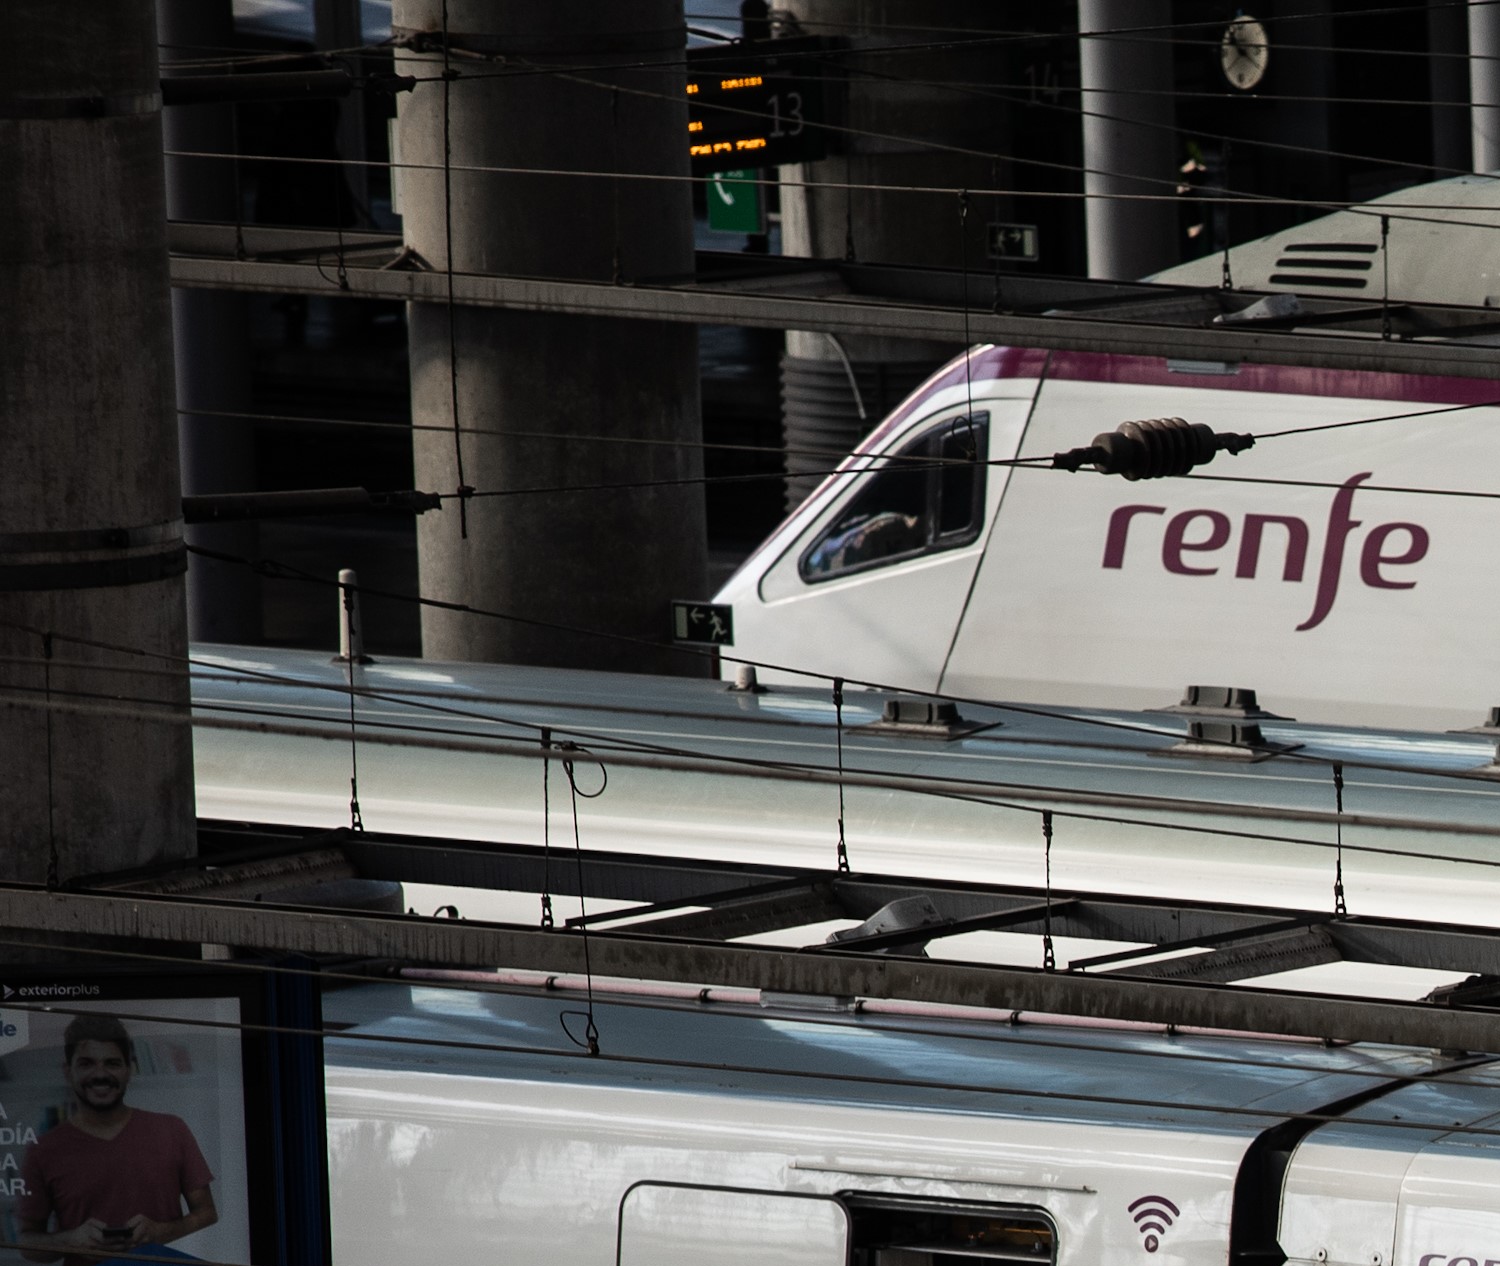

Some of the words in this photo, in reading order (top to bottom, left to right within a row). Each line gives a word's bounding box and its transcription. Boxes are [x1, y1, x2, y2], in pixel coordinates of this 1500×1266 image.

[766, 92, 803, 139] 13
[1102, 472, 1430, 632] renfe
[19, 983, 100, 996] exteriorplus
